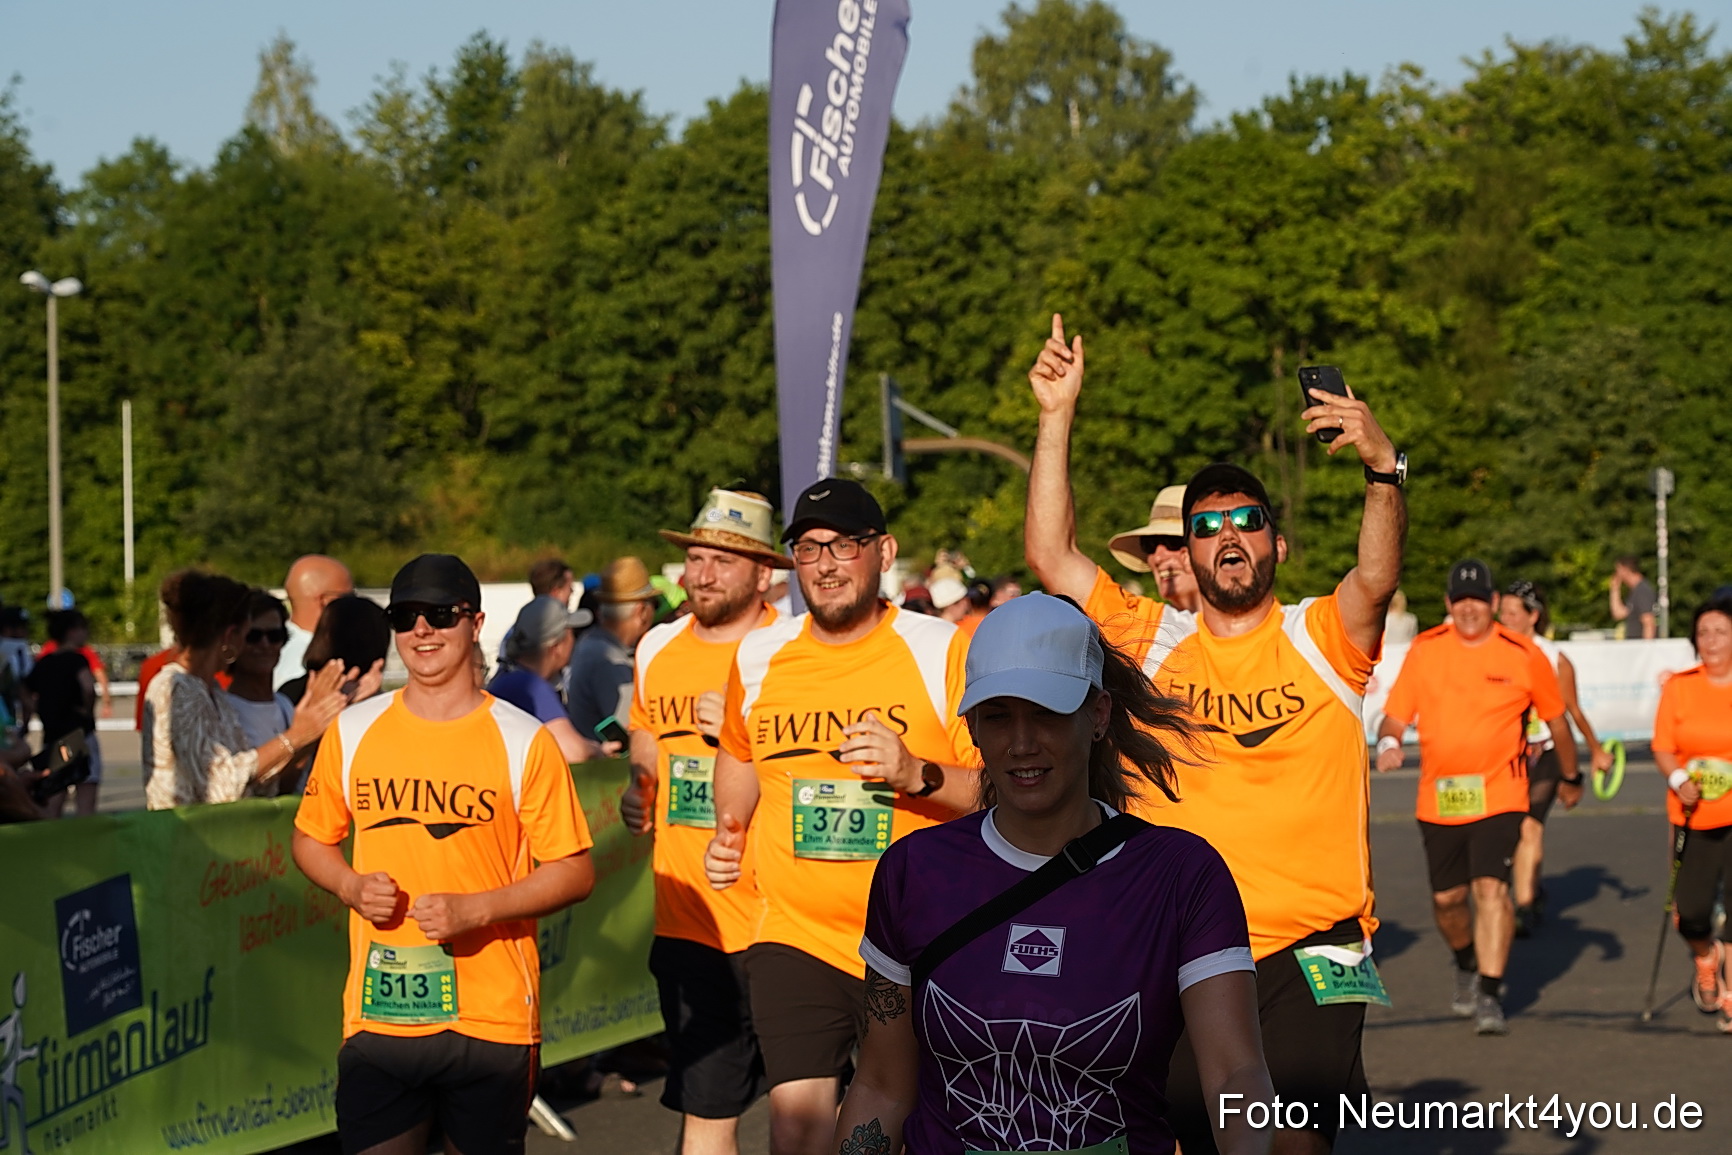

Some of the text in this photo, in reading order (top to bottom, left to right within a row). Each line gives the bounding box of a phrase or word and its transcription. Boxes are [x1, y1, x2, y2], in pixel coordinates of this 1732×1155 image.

[809, 0, 860, 191] Fische
[1188, 682, 1306, 726] WINGS
[756, 715, 771, 744] BIT
[356, 777, 370, 811] BIT
[372, 777, 497, 823] WINGS
[794, 813, 804, 842] RUN
[813, 807, 865, 834] 379
[876, 812, 889, 849] 2022
[1009, 943, 1059, 957] FUCHS
[364, 976, 373, 1005] RUN
[380, 972, 429, 998] 513
[440, 974, 453, 1012] 2022
[1308, 964, 1327, 990] RUN
[37, 966, 215, 1117] firmenlauf
[44, 1092, 118, 1150] neumarkt
